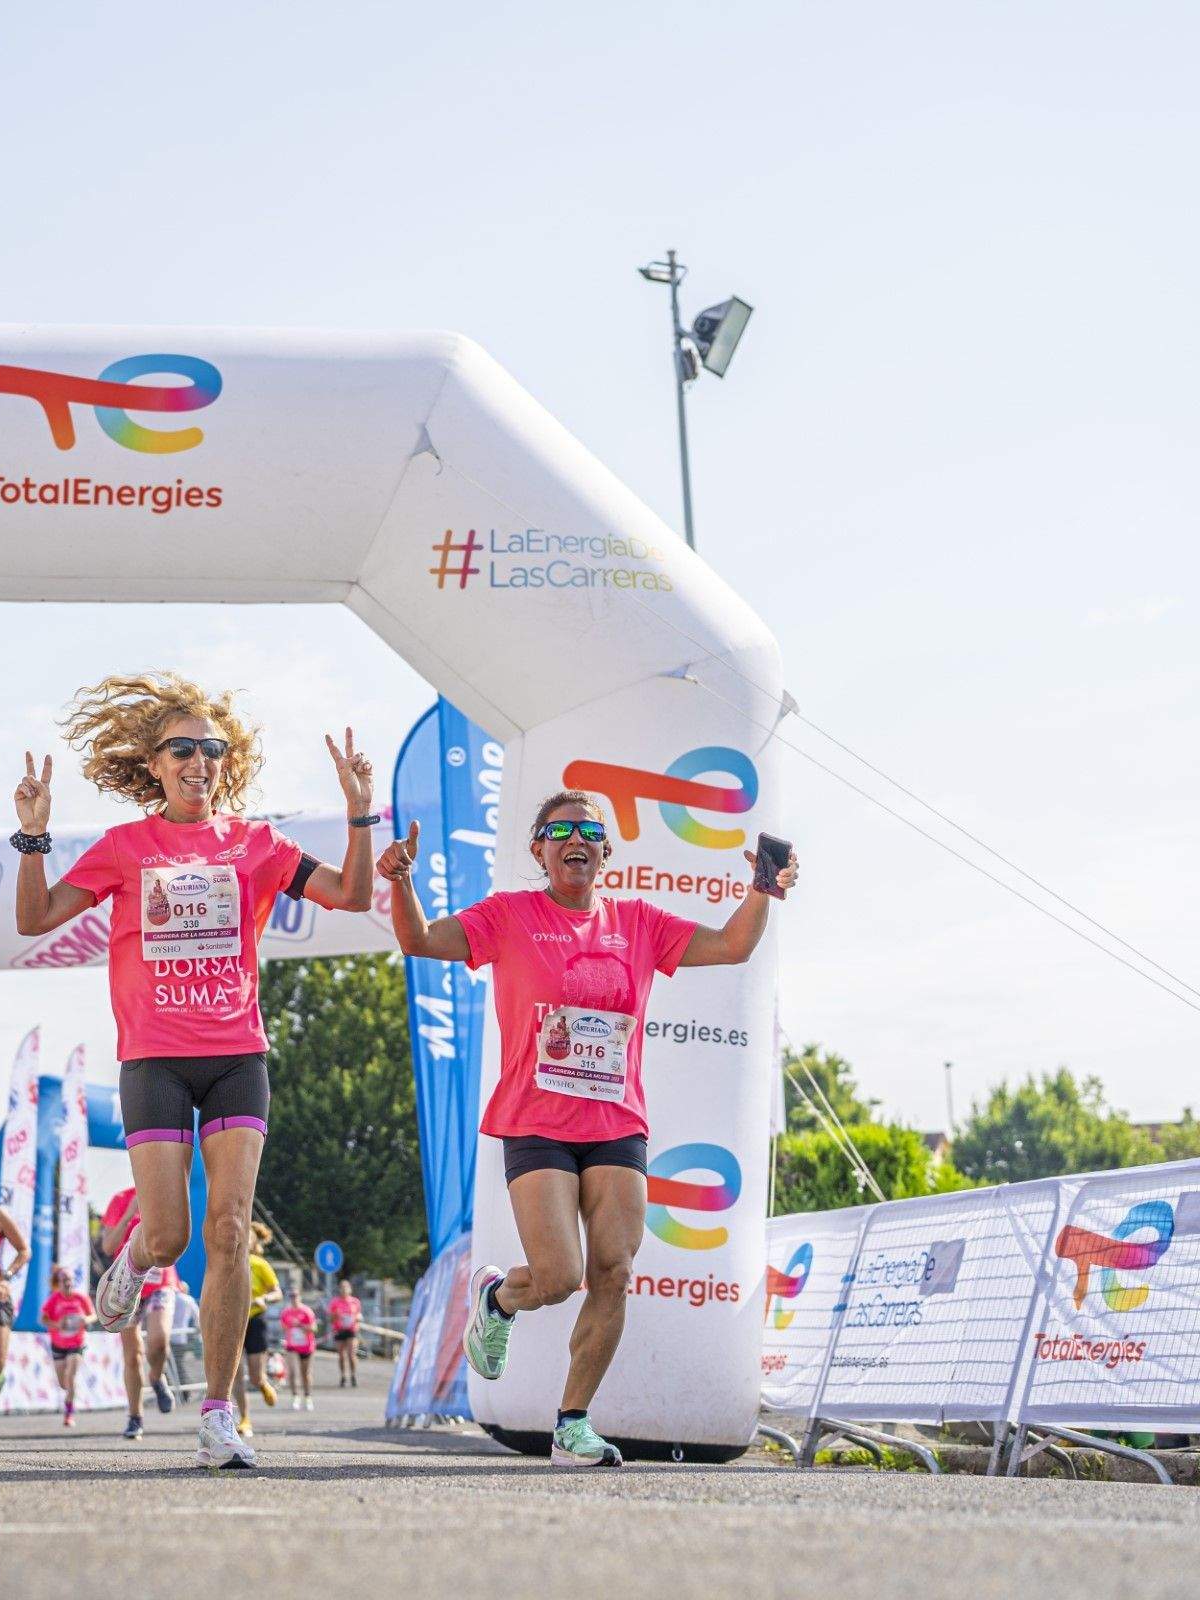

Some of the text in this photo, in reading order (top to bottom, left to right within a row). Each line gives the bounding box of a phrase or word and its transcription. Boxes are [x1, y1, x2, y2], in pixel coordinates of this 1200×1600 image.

[490, 560, 674, 593] LasCarreras
[173, 902, 207, 917] 016
[533, 933, 572, 944] OYSHO
[151, 945, 181, 954] OYSHO
[154, 955, 244, 977] DORSAL
[155, 983, 229, 1005] SUMA
[645, 1019, 748, 1047] ergies.es
[573, 1043, 606, 1058] 016
[580, 1060, 596, 1069] 315
[544, 1078, 575, 1089] OYSHO
[627, 1273, 740, 1308] nergies
[1033, 1333, 1147, 1370] TotalEnergies
